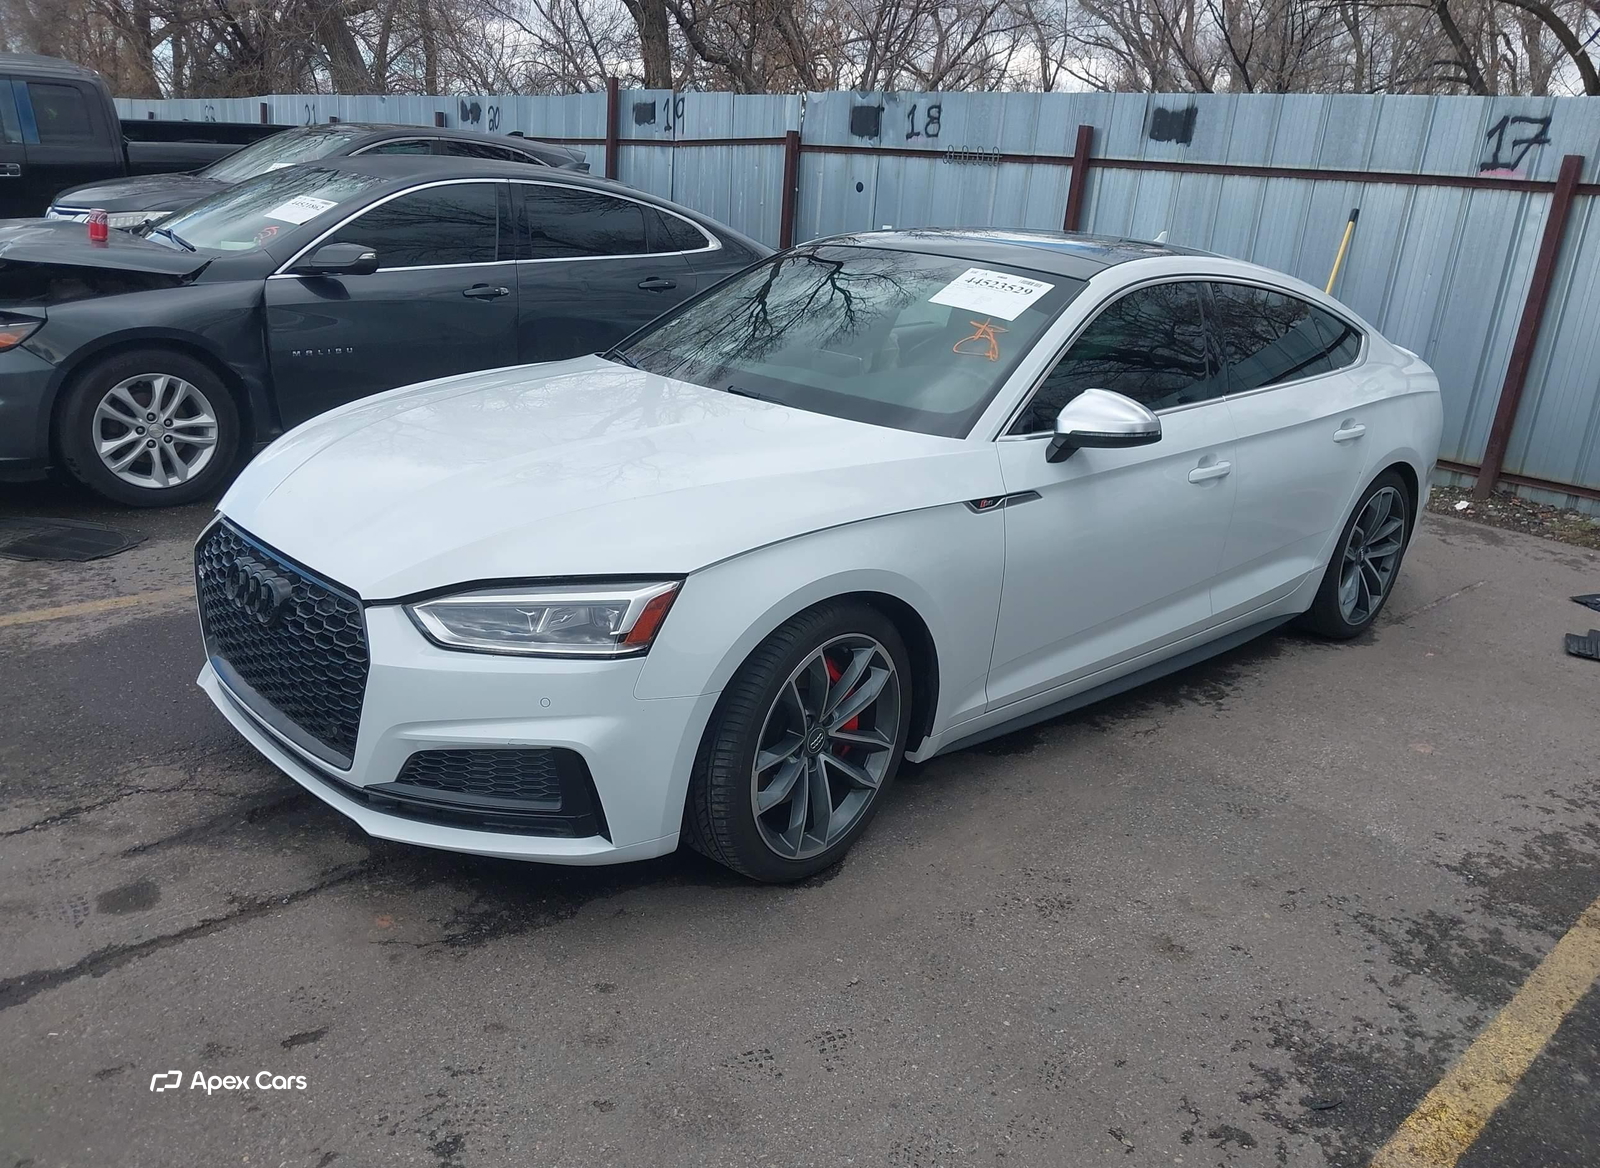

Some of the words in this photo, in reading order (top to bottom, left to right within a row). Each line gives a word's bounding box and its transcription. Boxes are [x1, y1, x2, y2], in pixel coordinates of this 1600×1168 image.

[488, 105, 500, 132] 20
[663, 97, 685, 135] 19
[905, 103, 942, 140] 18
[1480, 115, 1552, 172] 17
[965, 276, 1033, 296] 44523529
[292, 347, 353, 357] MALIBU
